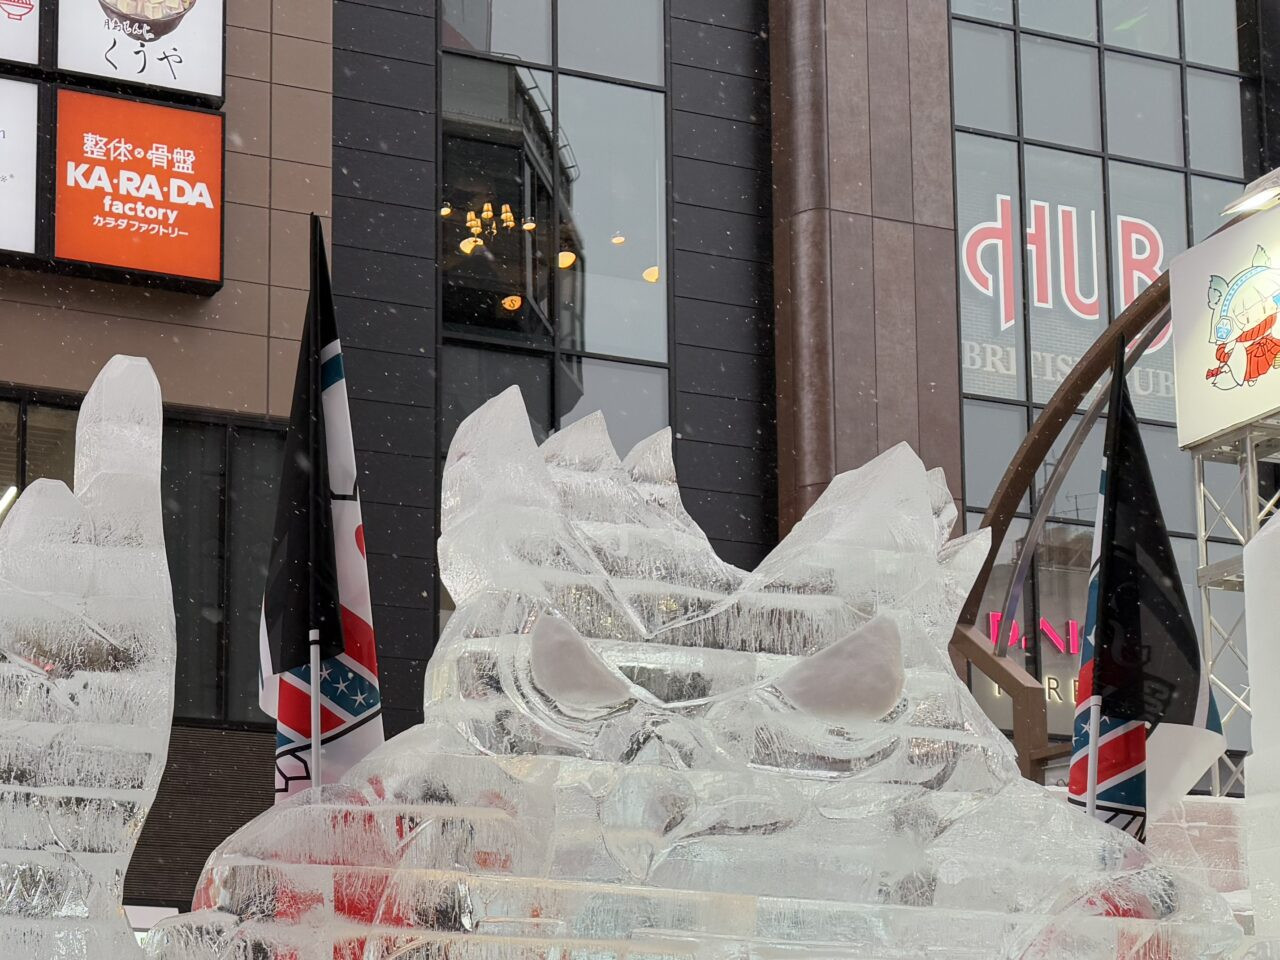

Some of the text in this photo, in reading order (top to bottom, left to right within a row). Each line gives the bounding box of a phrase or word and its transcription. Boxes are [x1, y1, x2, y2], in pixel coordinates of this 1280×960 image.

[104, 38, 183, 80] くうや
[93, 215, 189, 237] カラダファクトリー
[103, 196, 178, 224] factory
[962, 194, 1172, 355] HUB
